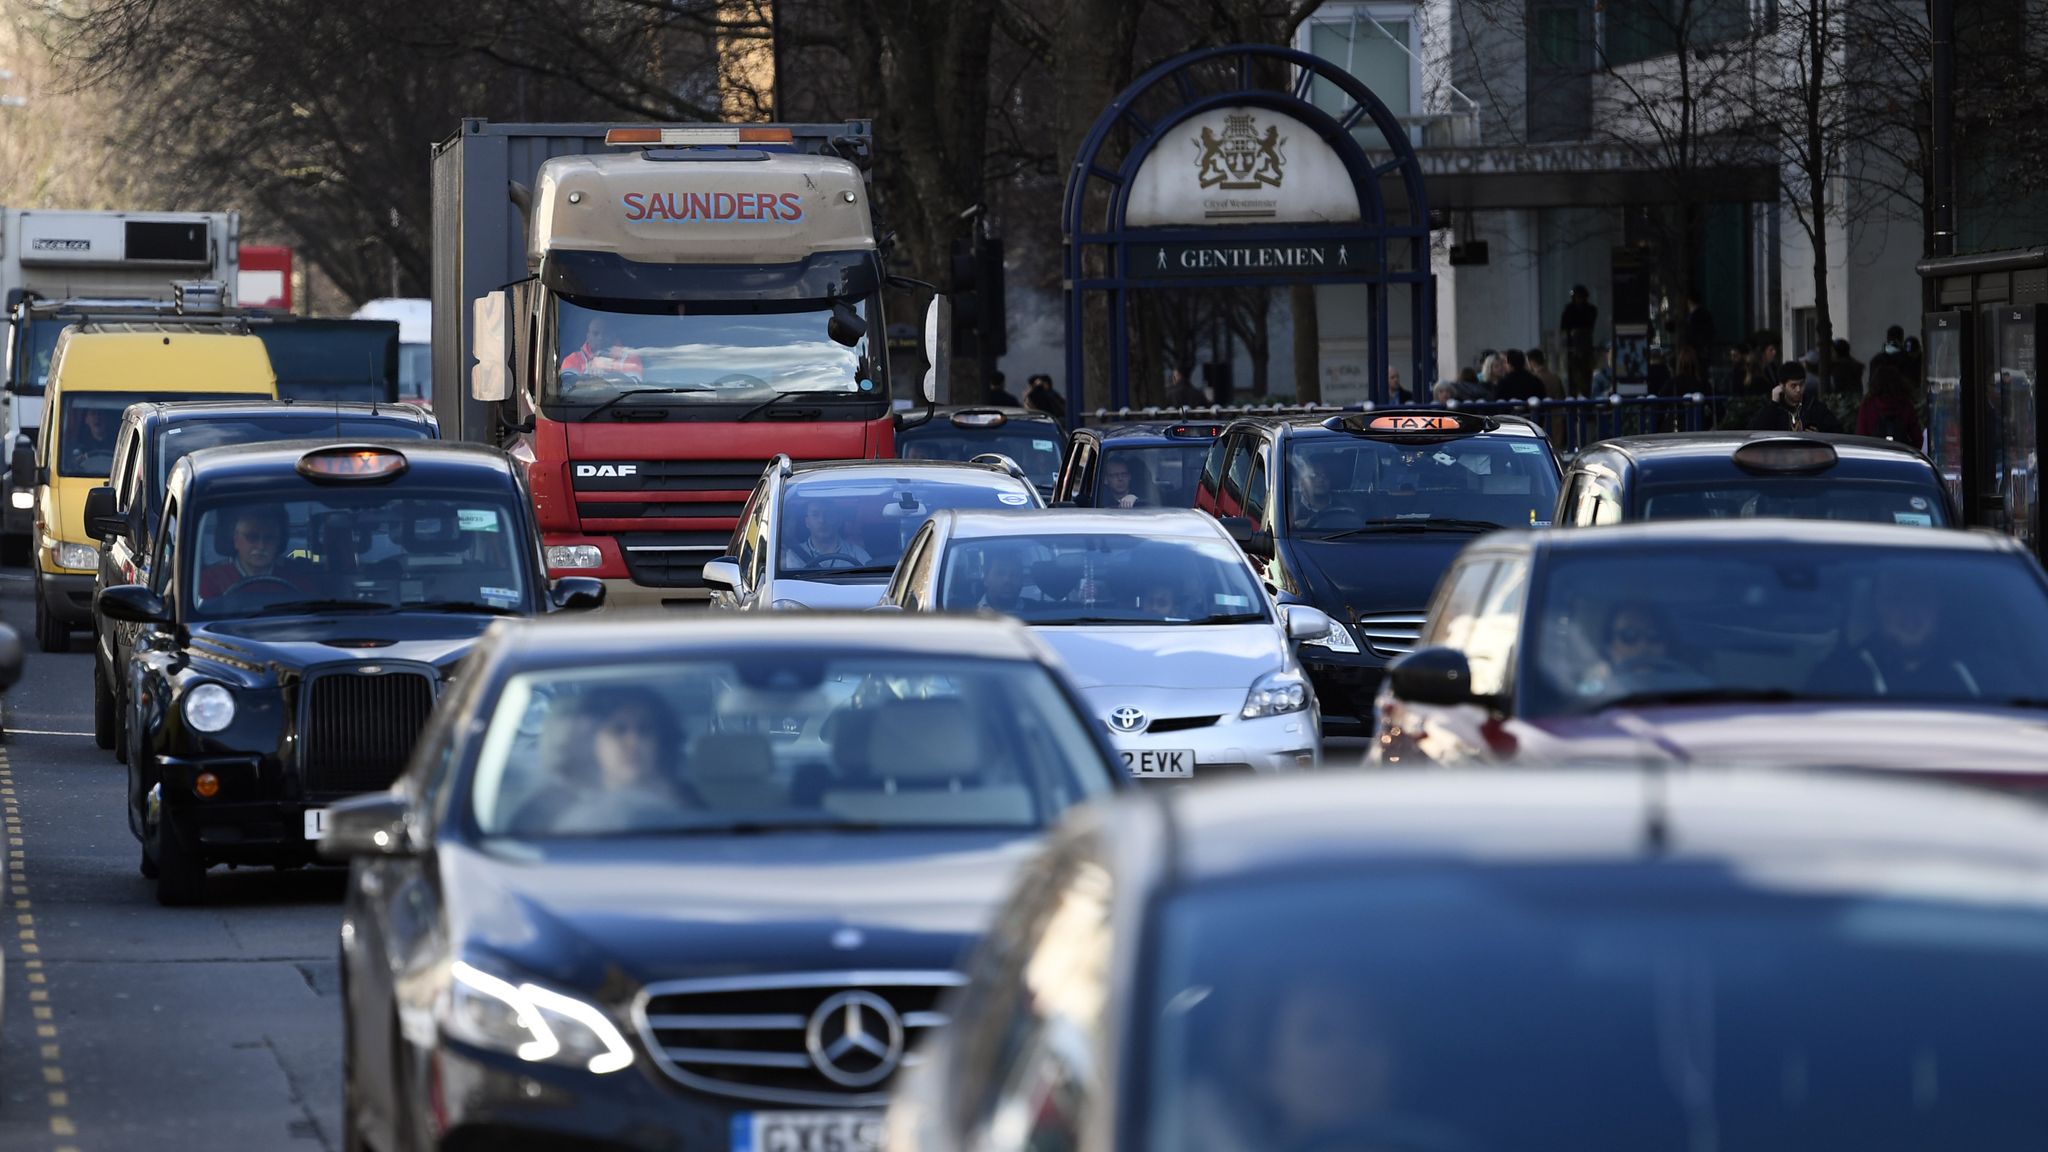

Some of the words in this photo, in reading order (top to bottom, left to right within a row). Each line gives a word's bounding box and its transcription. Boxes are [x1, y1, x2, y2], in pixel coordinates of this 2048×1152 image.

[623, 192, 804, 223] SAUNDERS
[1180, 248, 1325, 268] GENTLEMEN
[1388, 417, 1443, 429] TAXI
[324, 454, 386, 473] TAXI
[576, 464, 637, 477] DAF
[1141, 752, 1183, 772] EVK
